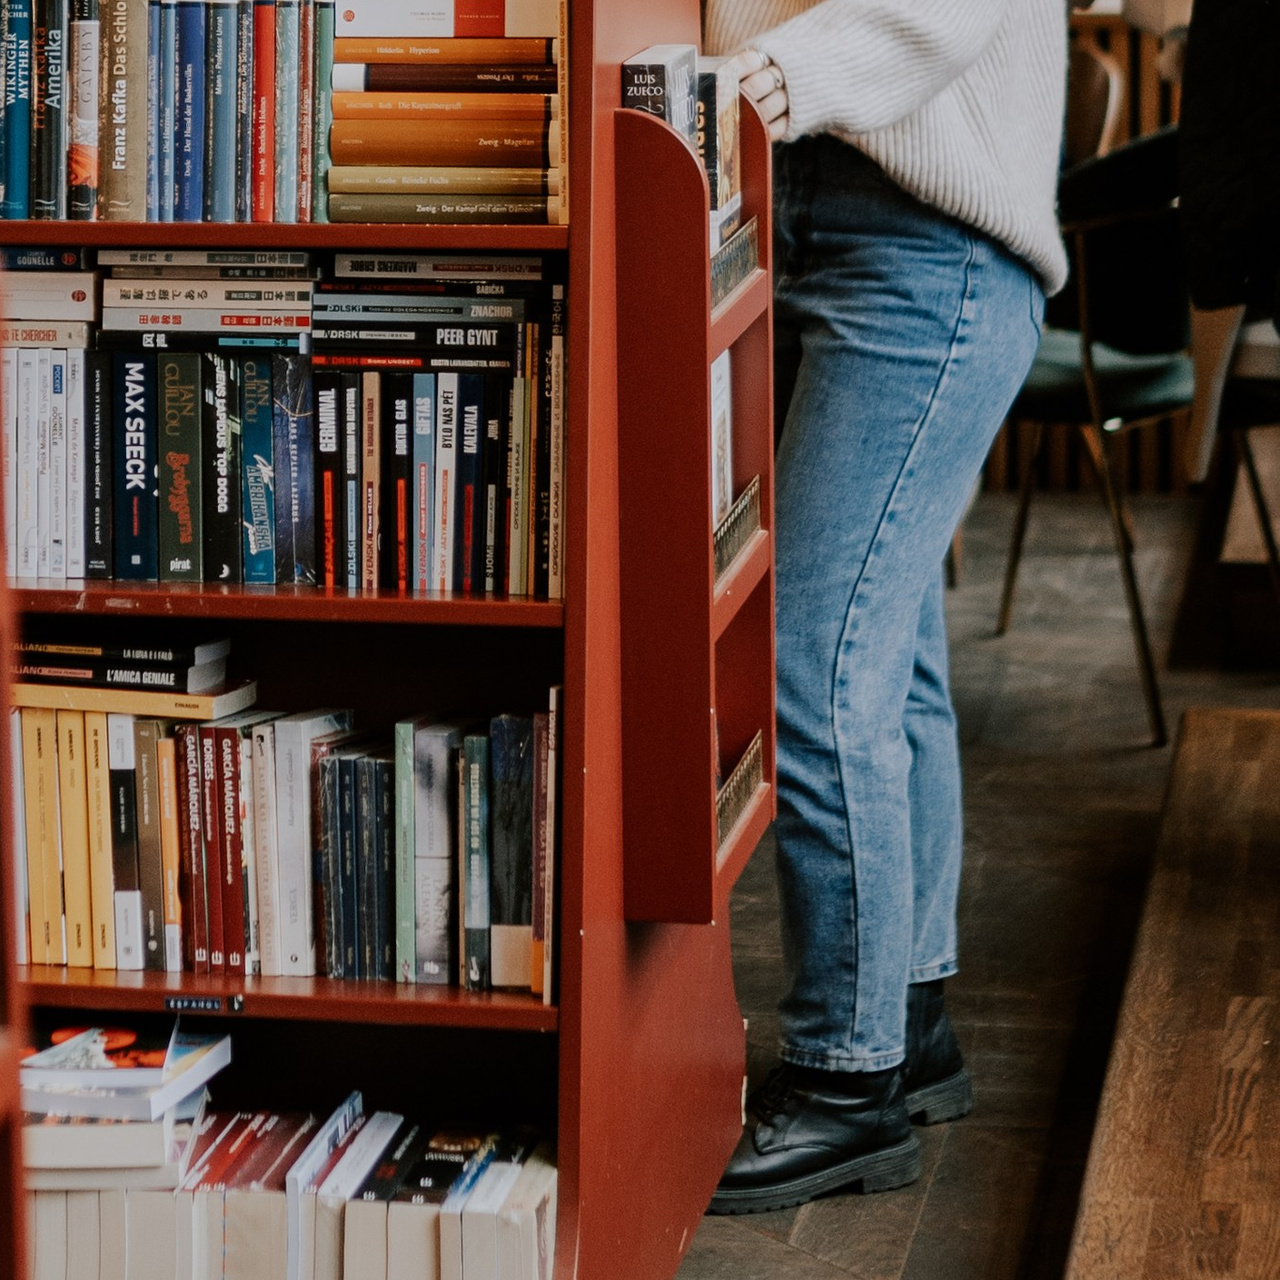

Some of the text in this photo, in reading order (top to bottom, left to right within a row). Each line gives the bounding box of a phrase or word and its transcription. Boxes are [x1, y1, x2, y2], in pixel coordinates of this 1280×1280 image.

[7, 33, 16, 105] WIKINGER
[18, 39, 28, 99] MYTHEN
[45, 29, 61, 109] Amerika
[82, 28, 92, 103] GATSBY
[113, 42, 127, 75] Das
[240, 64, 249, 76] Die
[184, 64, 192, 104] Baskervilles
[627, 86, 663, 96] ZUECO
[634, 75, 655, 84] LUIS
[112, 80, 126, 124] Kafka
[184, 105, 192, 116] der
[240, 82, 249, 114] Andersen
[258, 96, 266, 123] Holmes
[184, 118, 192, 137] Hund
[258, 124, 266, 154] Sherlock
[478, 138, 534, 147] Zweig Magellan
[112, 129, 127, 170] Franz
[184, 139, 192, 152] Der
[416, 205, 436, 214] Zweig
[442, 205, 454, 214] Der
[455, 205, 478, 214] Kampf
[479, 205, 490, 214] mit
[491, 205, 507, 214] dem
[17, 256, 54, 266] GOUNELLE
[378, 260, 417, 272] MARKENS
[476, 285, 504, 295] BABIČKA
[470, 305, 513, 317] ZNACHOR
[21, 329, 57, 341] CHERCHER
[436, 329, 498, 346] PEER GYNT
[165, 363, 180, 436] GUILLOU
[181, 385, 195, 416] JAN
[254, 379, 268, 407] JAN
[124, 362, 146, 490] MAX SEECK
[319, 388, 337, 452] GERMINAL
[395, 399, 407, 455] DOKTOR GLAS
[441, 407, 453, 449] BYLO NÁS
[464, 405, 478, 454] KALEVALA
[71, 442, 78, 451] de
[217, 452, 228, 476] TOP
[217, 478, 228, 514] DOGG
[247, 466, 272, 551] AMERIKANSKA
[552, 481, 560, 519] СКАЗКИ
[170, 558, 191, 571] pirat
[107, 669, 175, 685] L'AMICA GENIALE
[186, 735, 198, 775] GARCÍA
[203, 738, 214, 780] BORGES
[222, 739, 235, 778] GARCÍA
[188, 777, 199, 830] MÁRQUEZ
[224, 780, 236, 833] MÁRQUEZ
